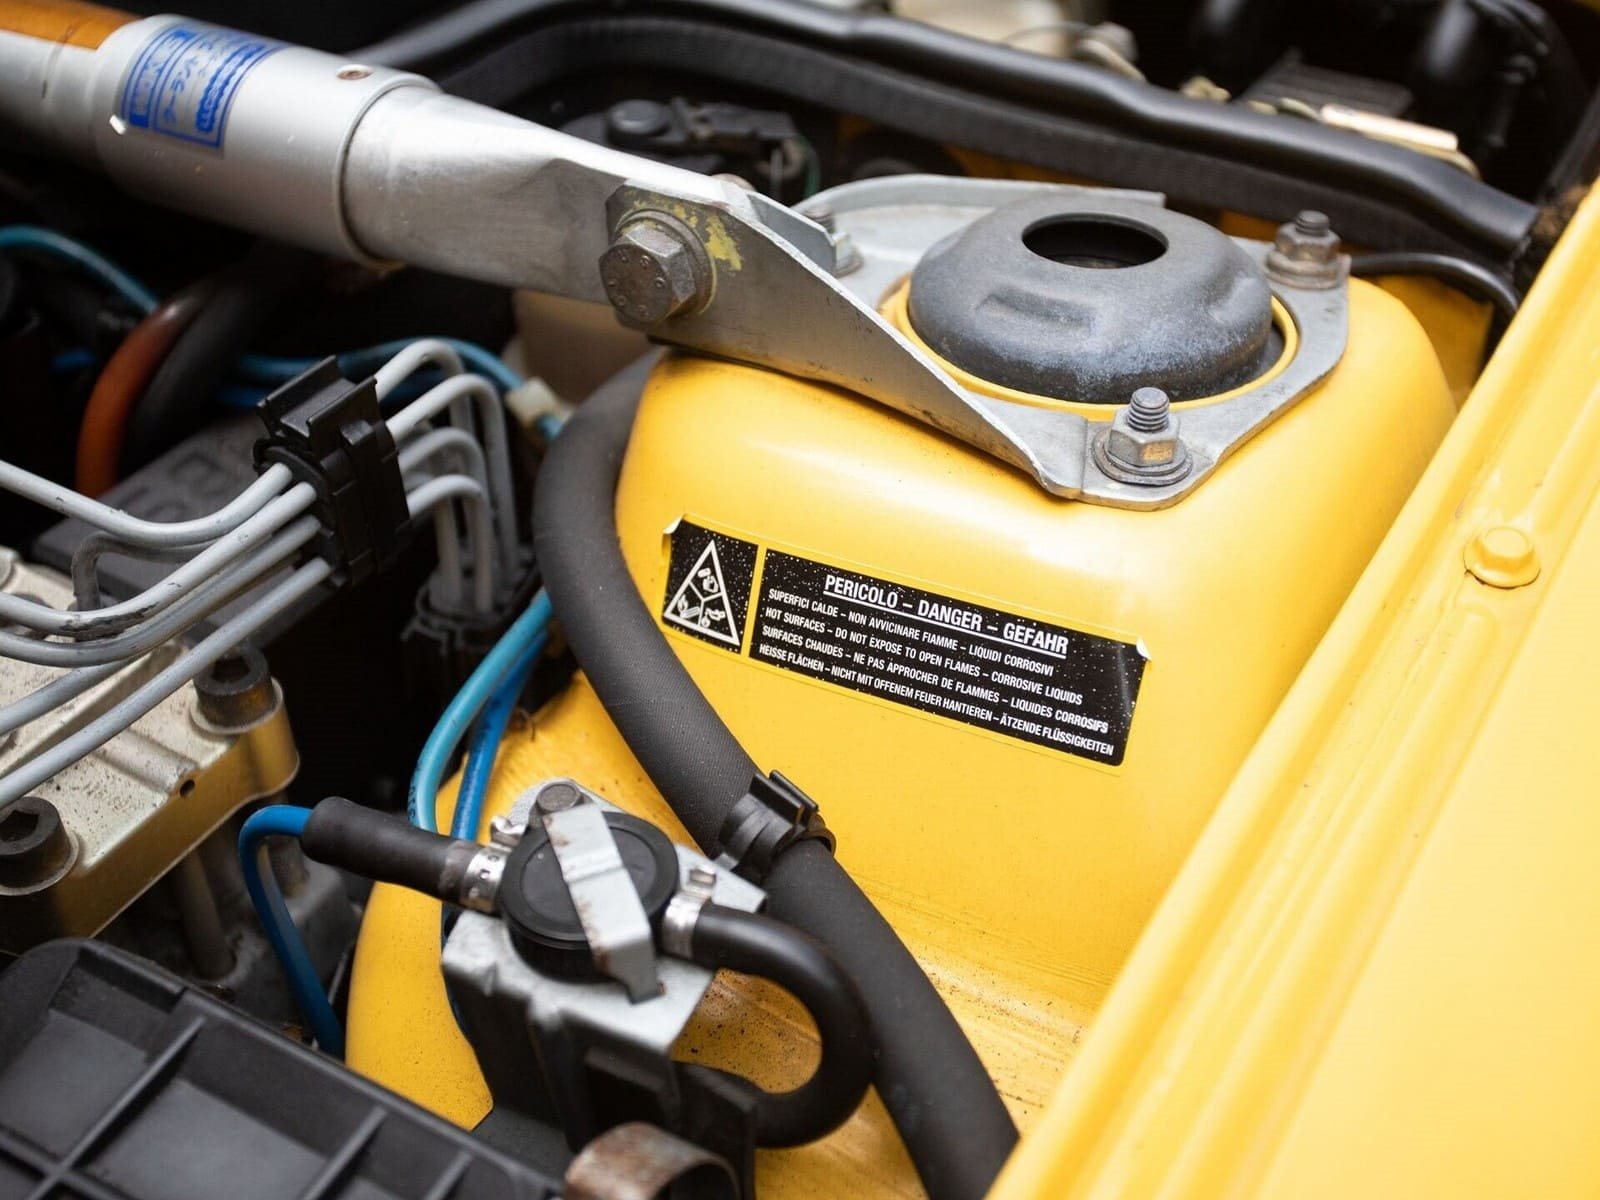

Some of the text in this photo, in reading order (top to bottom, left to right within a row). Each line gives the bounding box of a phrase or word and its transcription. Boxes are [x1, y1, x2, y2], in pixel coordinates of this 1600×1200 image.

[766, 607, 781, 620] HOT
[783, 613, 826, 633] SURFACES
[835, 627, 848, 639] DO
[850, 632, 867, 645] NOT
[869, 637, 902, 655] EXPOSE
[905, 647, 916, 659] TO
[919, 650, 942, 667] OPEN
[944, 658, 980, 677] FLAMES
[991, 671, 1043, 695] CORROSIVE
[1045, 686, 1083, 705] LIQUIDS
[769, 588, 809, 609] SUPERFICI
[812, 600, 838, 618] CALDE
[848, 611, 867, 626] NON
[868, 617, 920, 640] AVVICINARE
[922, 632, 959, 650] FIAMME
[969, 644, 1001, 663] LIQUIDI
[1004, 654, 1054, 676] CORROSIVI
[825, 574, 898, 608] PERICOLO
[918, 599, 983, 631] DANGER
[1003, 622, 1069, 654] GEFAHR
[759, 644, 787, 661] HEISSE
[787, 651, 824, 673] FLÄCHEN
[831, 666, 856, 681] NICHT
[857, 672, 874, 686] MIT
[874, 678, 914, 699] OFFENEM
[914, 687, 942, 707] FEUER
[943, 698, 992, 722] HANTIEREN
[1000, 712, 1042, 736] ÄTZENDE
[1042, 727, 1114, 756] FLÜSSIGKEITEN
[762, 625, 803, 646] SURFACES
[805, 638, 844, 658] CHAUDES
[853, 652, 865, 665] NE
[868, 656, 885, 670] PAS
[887, 662, 939, 685] APPROCHER
[941, 677, 953, 690] DE
[955, 681, 1000, 703] FLAMMES
[1010, 697, 1053, 718] LIQUIDES
[1055, 709, 1109, 734] CORROSIFS
